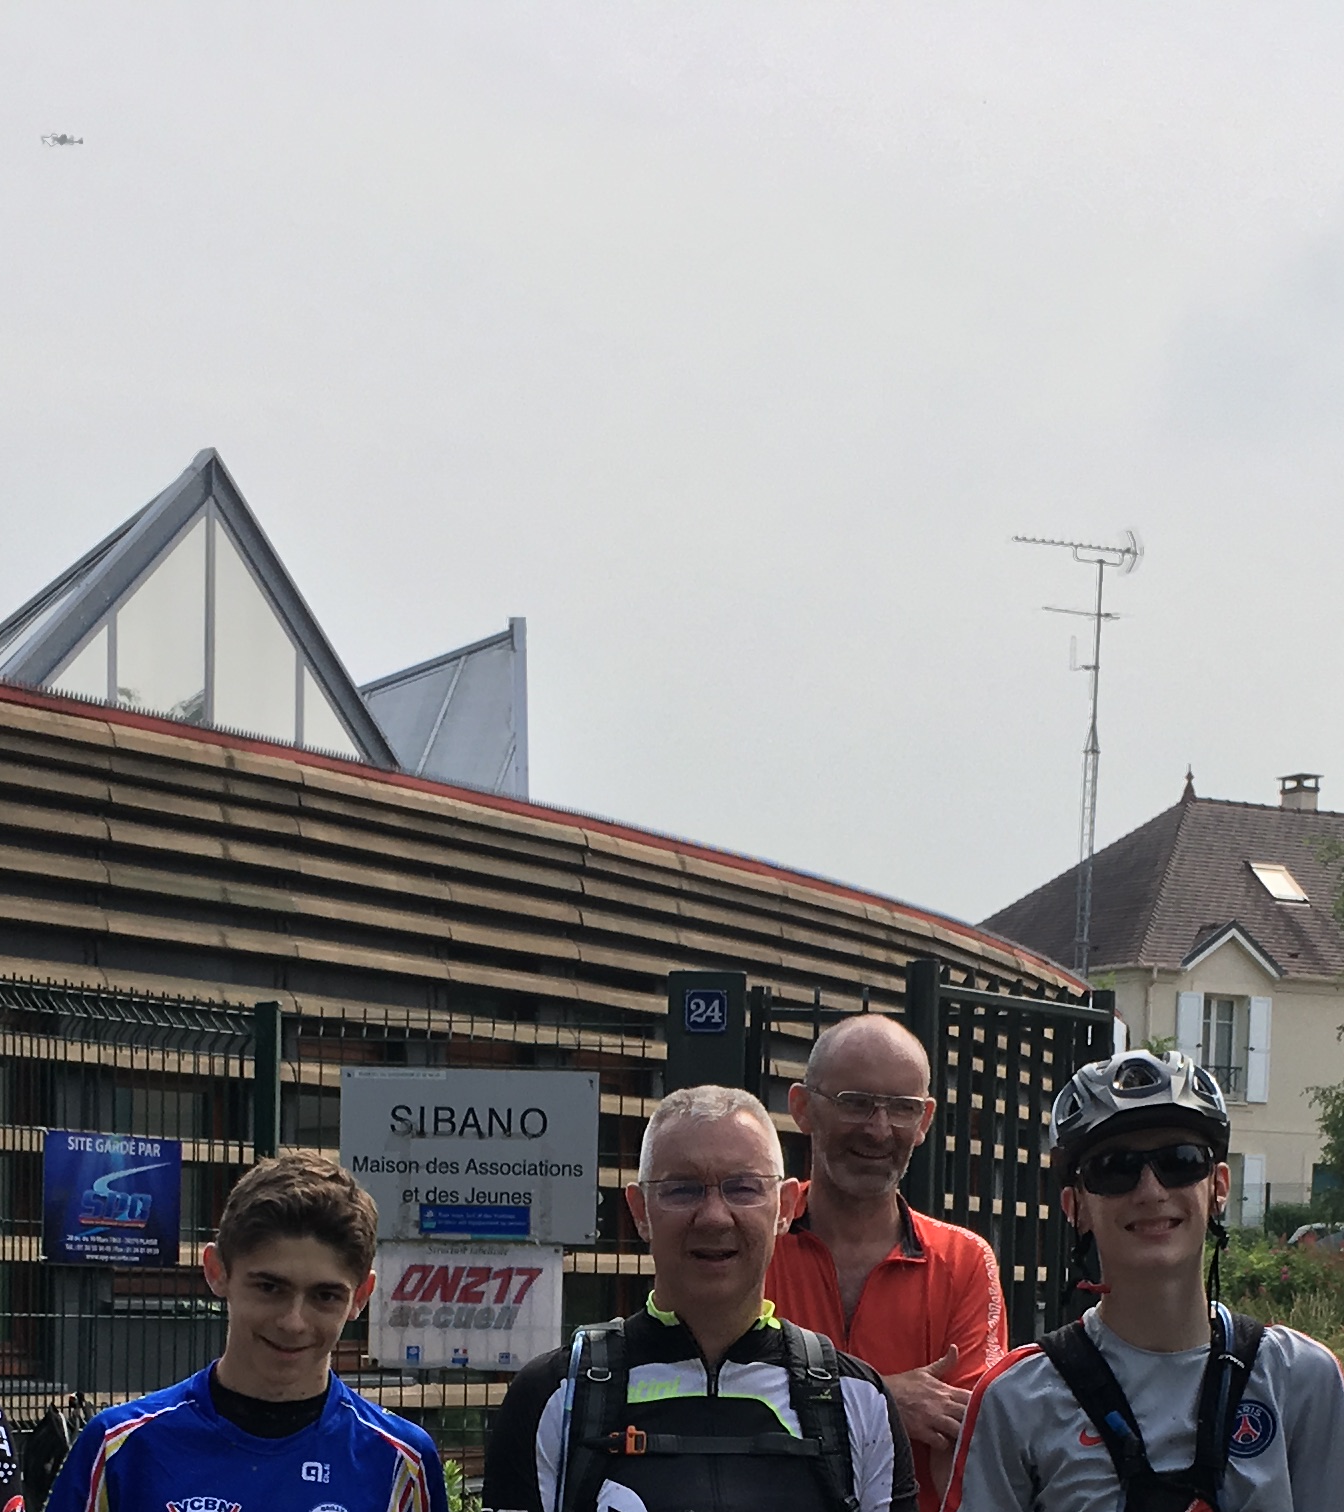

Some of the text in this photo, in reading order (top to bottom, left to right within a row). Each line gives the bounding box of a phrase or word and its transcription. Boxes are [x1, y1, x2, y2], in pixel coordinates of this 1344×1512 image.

[690, 998, 723, 1023] 24
[390, 1104, 549, 1140] SIBANO
[67, 1136, 161, 1158] SITE GARDÉ PAR
[352, 1156, 584, 1178] Maison des Associations
[402, 1187, 533, 1206] et des Jeunes
[388, 1305, 521, 1330] accueil
